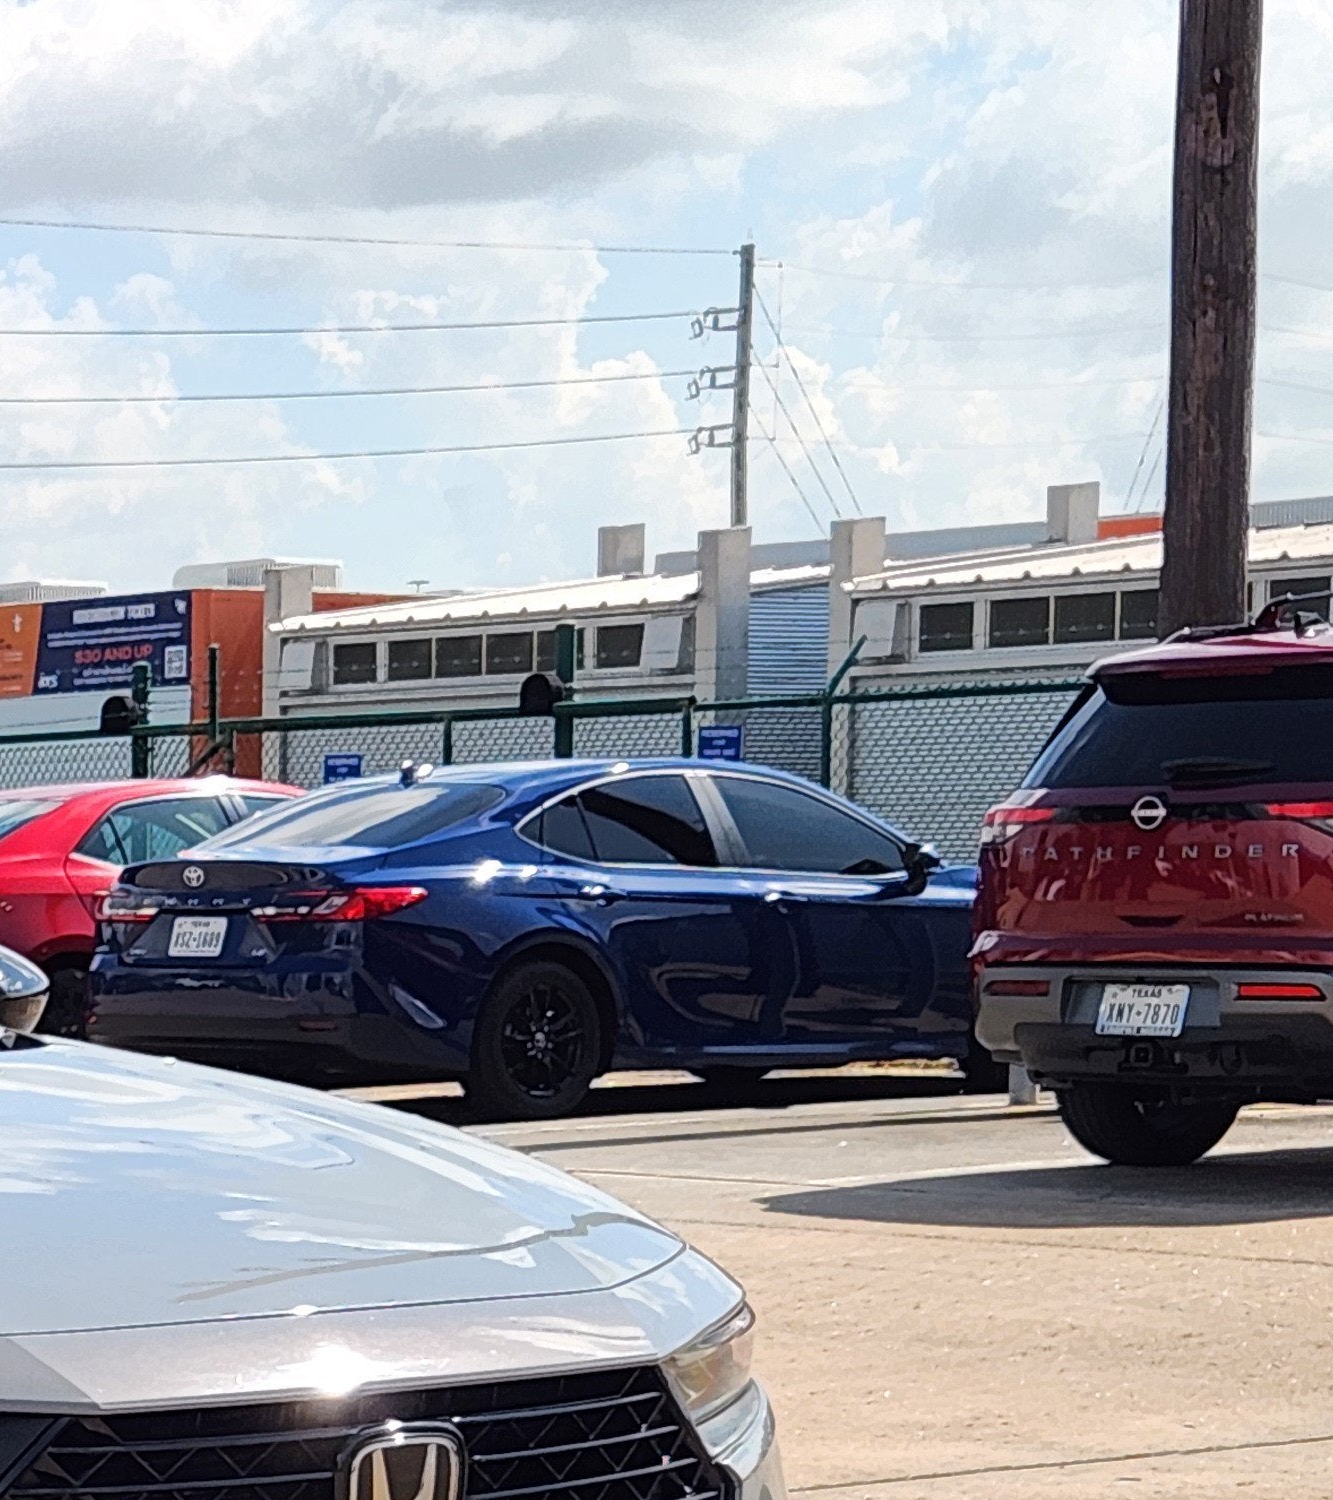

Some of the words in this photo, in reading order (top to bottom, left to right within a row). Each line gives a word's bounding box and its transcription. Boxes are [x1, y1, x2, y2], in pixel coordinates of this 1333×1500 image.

[74, 648, 102, 664] $30
[104, 646, 132, 661] AND
[133, 644, 153, 658] UP
[1020, 843, 1300, 861] PATHFINDER
